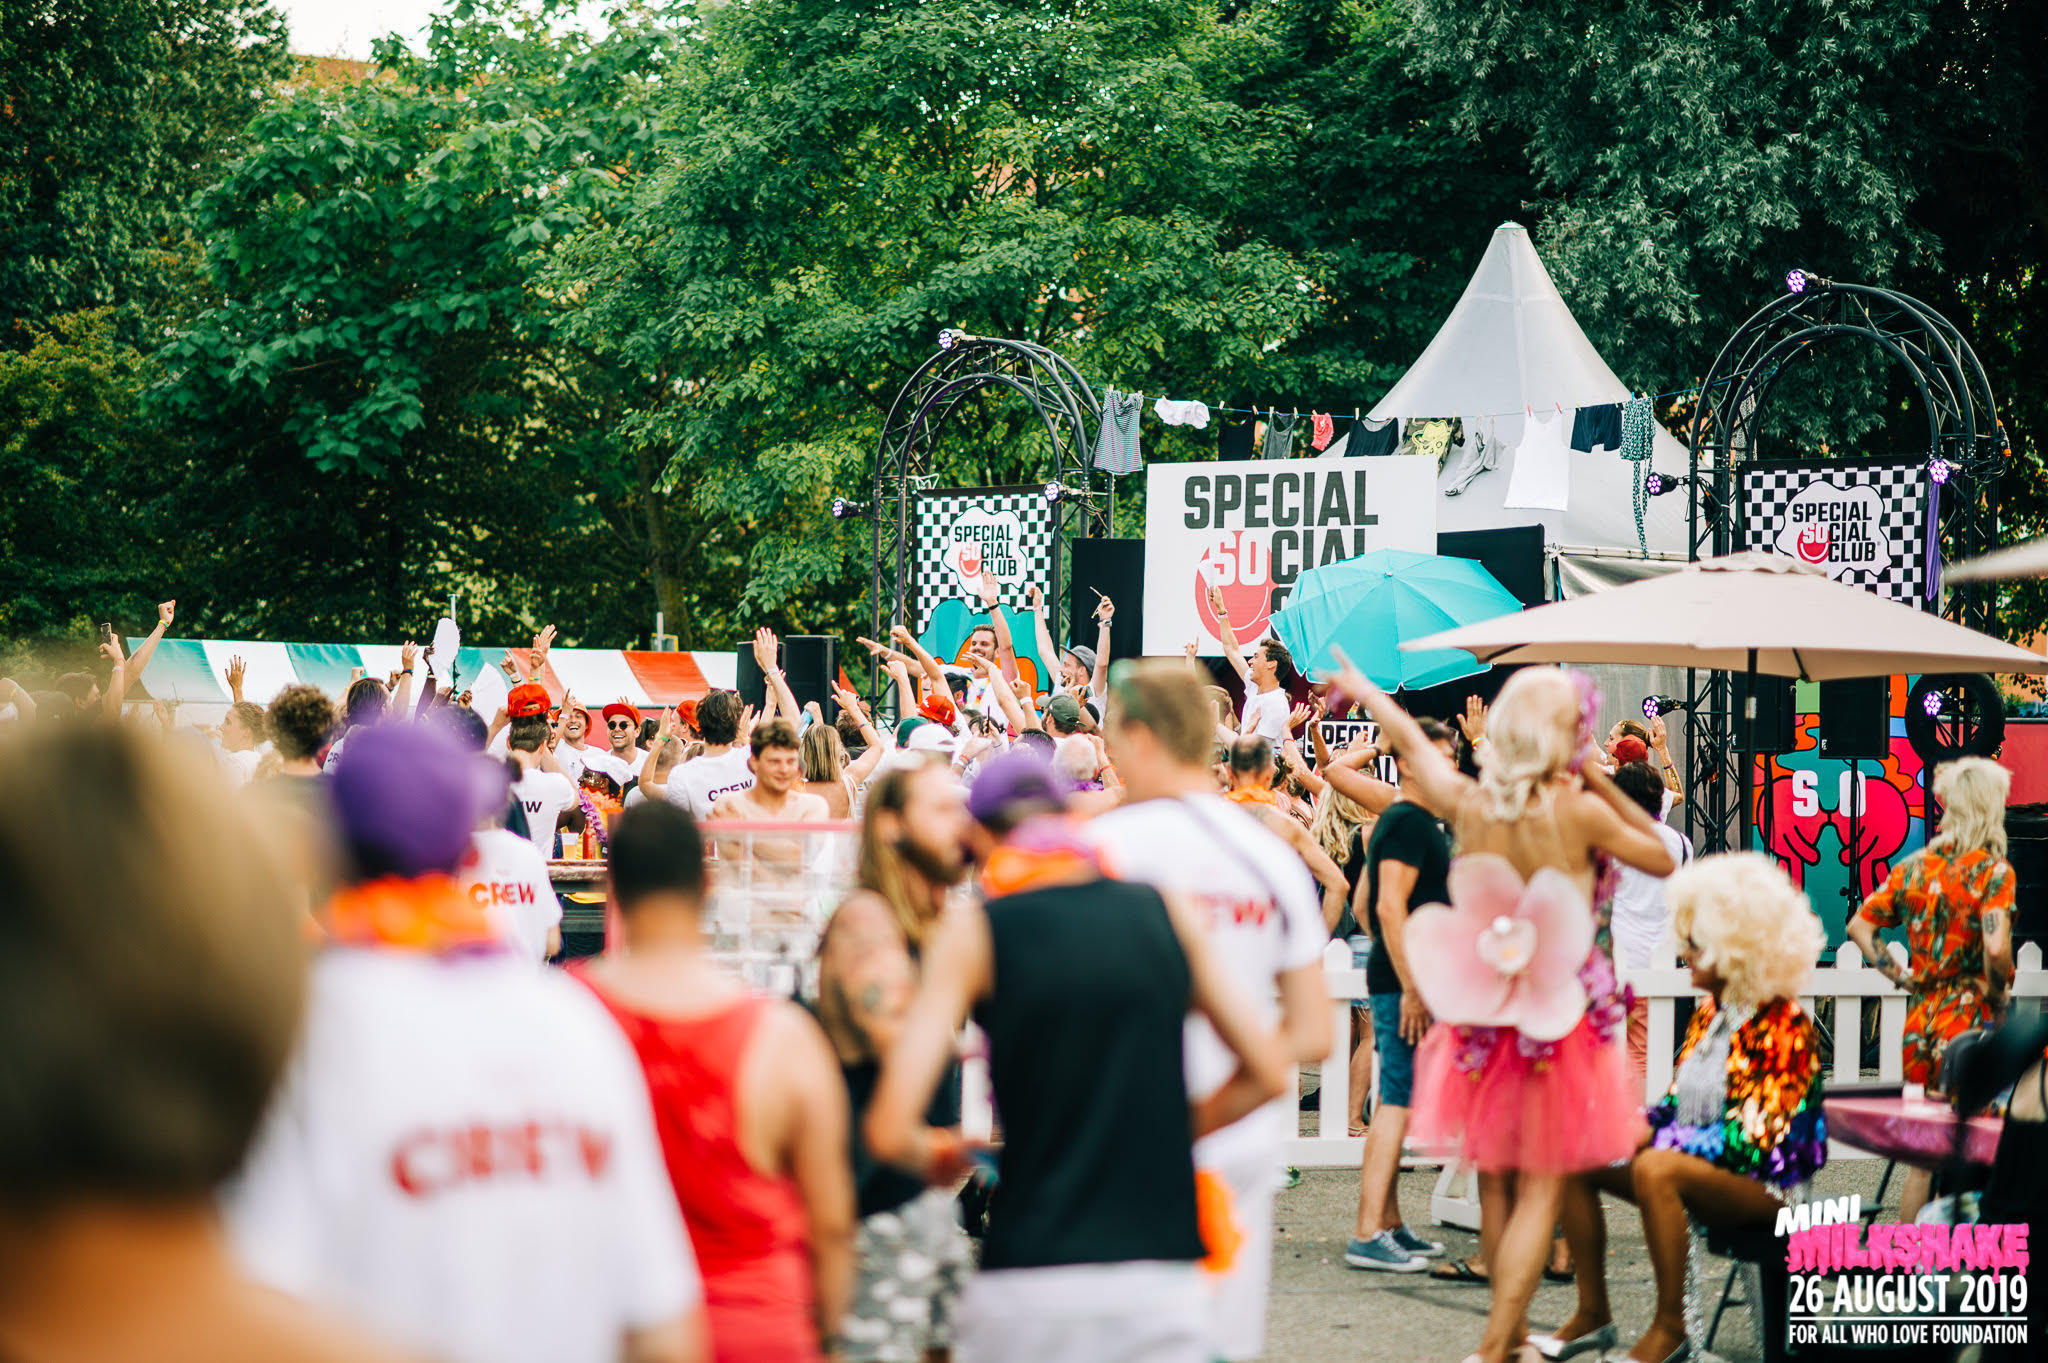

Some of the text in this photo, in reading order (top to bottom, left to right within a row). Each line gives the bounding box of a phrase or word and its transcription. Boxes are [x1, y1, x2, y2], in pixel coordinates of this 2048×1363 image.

[1184, 470, 1379, 529] SPECIAL
[1792, 501, 1872, 523] SPECIAL
[954, 524, 1014, 542] SPECIAL
[1803, 522, 1872, 544] SOCIAL
[1828, 541, 1876, 563] CLUB
[980, 559, 1017, 576] CLUB
[468, 882, 535, 910] CREW
